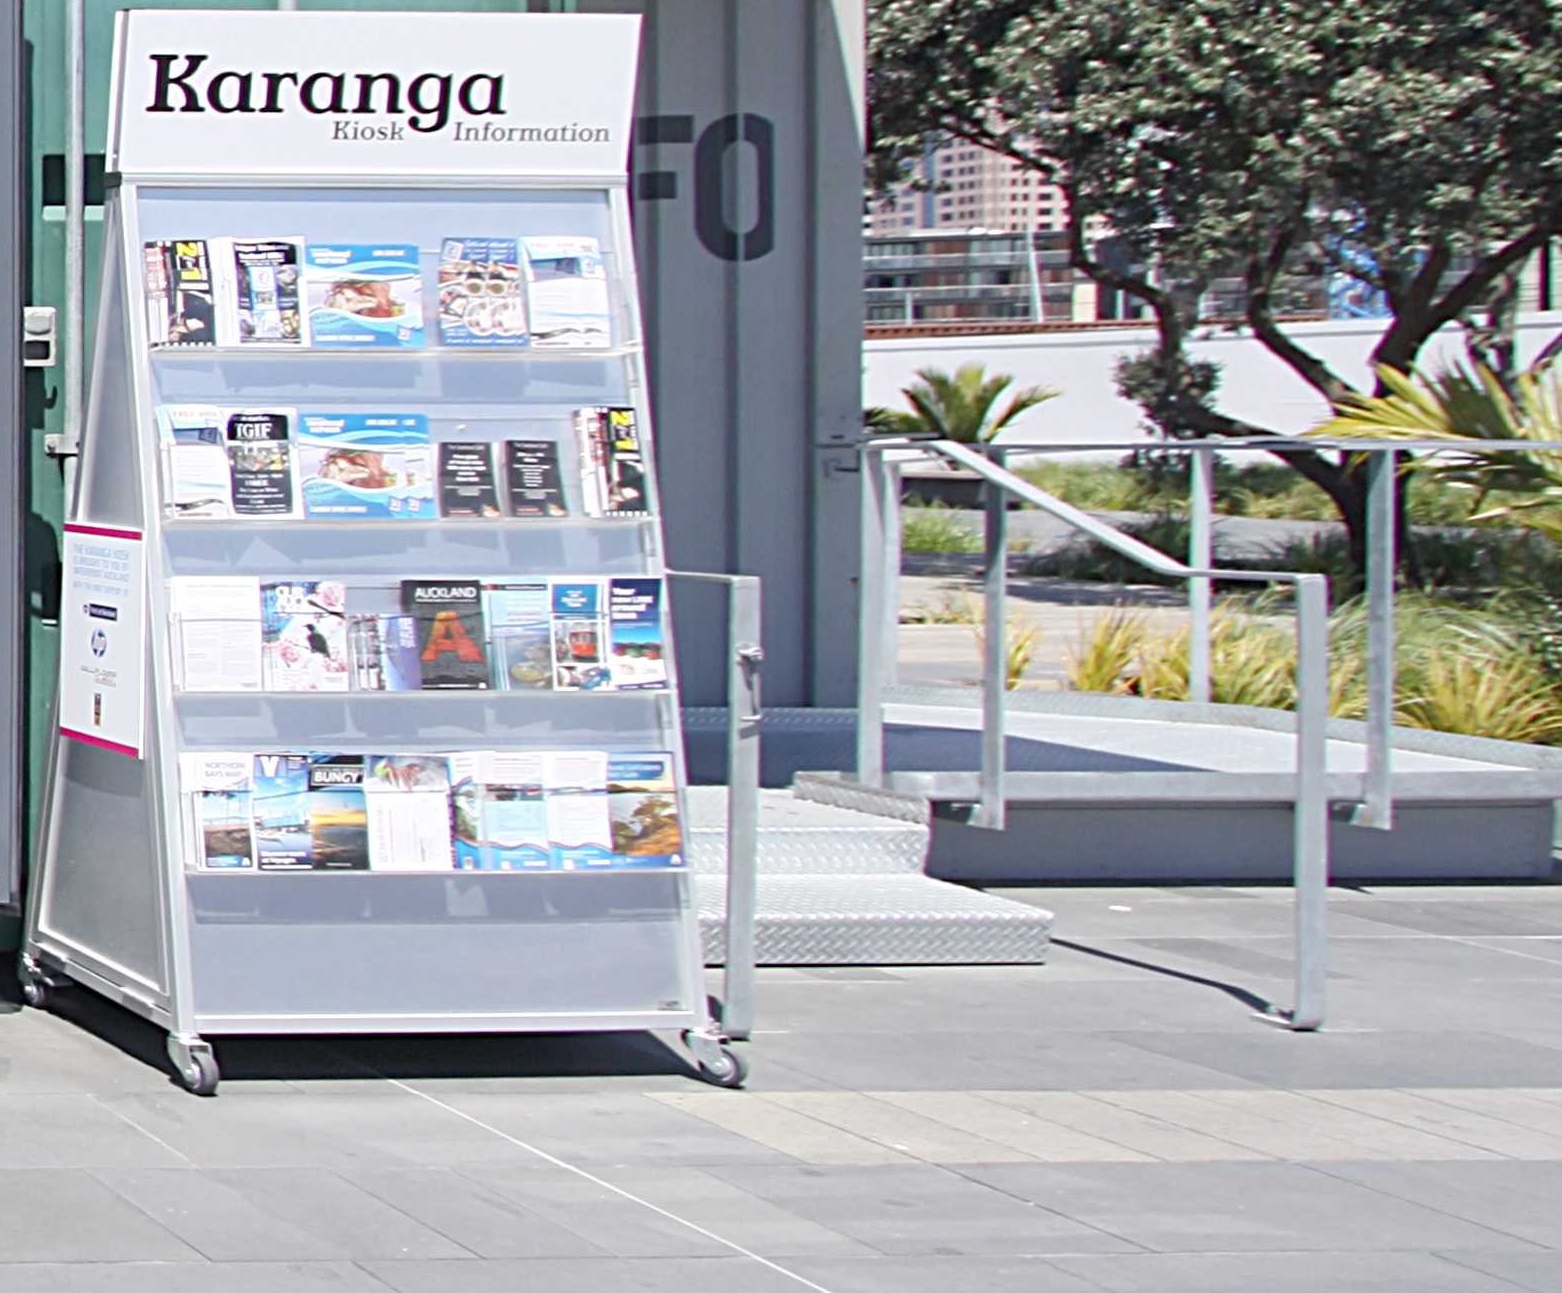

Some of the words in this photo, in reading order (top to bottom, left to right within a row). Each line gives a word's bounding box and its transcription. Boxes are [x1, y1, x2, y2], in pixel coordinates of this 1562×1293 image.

[146, 54, 507, 133] Karanga
[331, 121, 405, 141] Kiosk
[453, 121, 611, 142] Information
[415, 587, 477, 598] AUCKLAND
[420, 611, 486, 663] A
